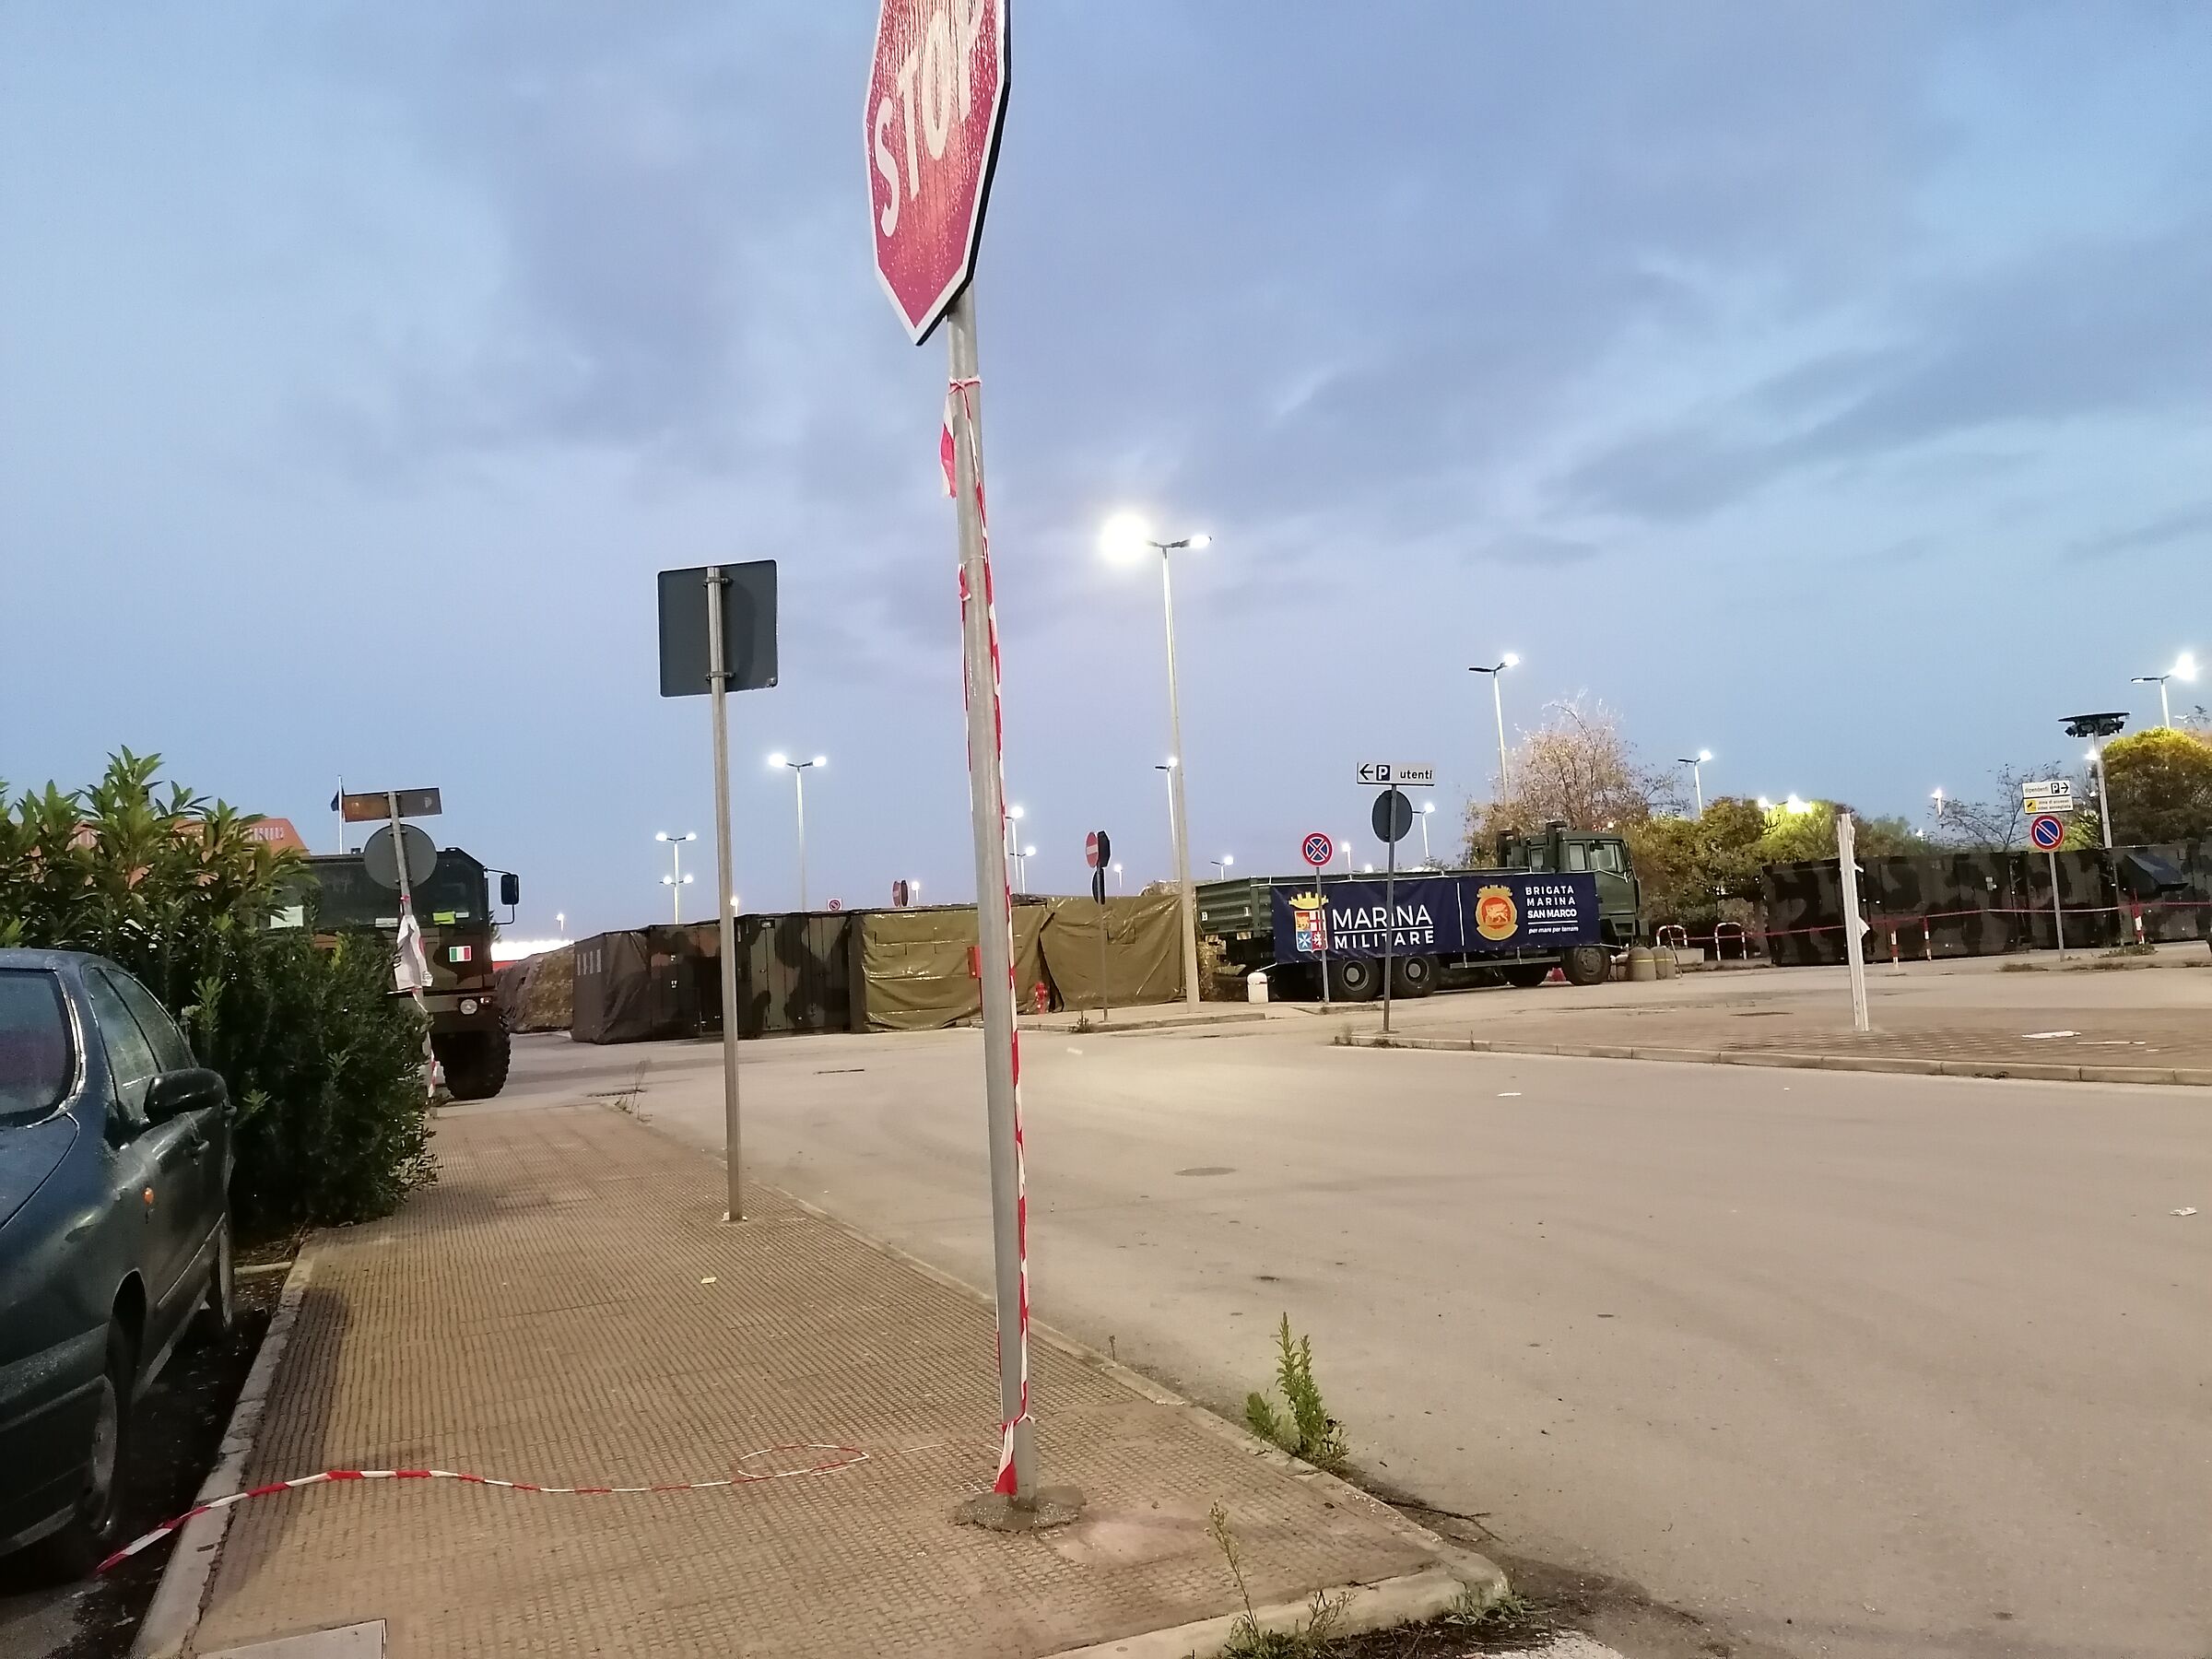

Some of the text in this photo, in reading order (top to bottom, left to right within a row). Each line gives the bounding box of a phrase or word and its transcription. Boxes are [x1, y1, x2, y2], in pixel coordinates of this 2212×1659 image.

[875, 0, 986, 238] STOP
[1400, 770, 1433, 780] utenti
[1525, 885, 1574, 896] BRIGATA
[1526, 896, 1576, 907] MARINA
[1332, 904, 1433, 931] MARINA
[1527, 909, 1577, 919] SAN MARCO
[1334, 930, 1434, 950] MILITARE
